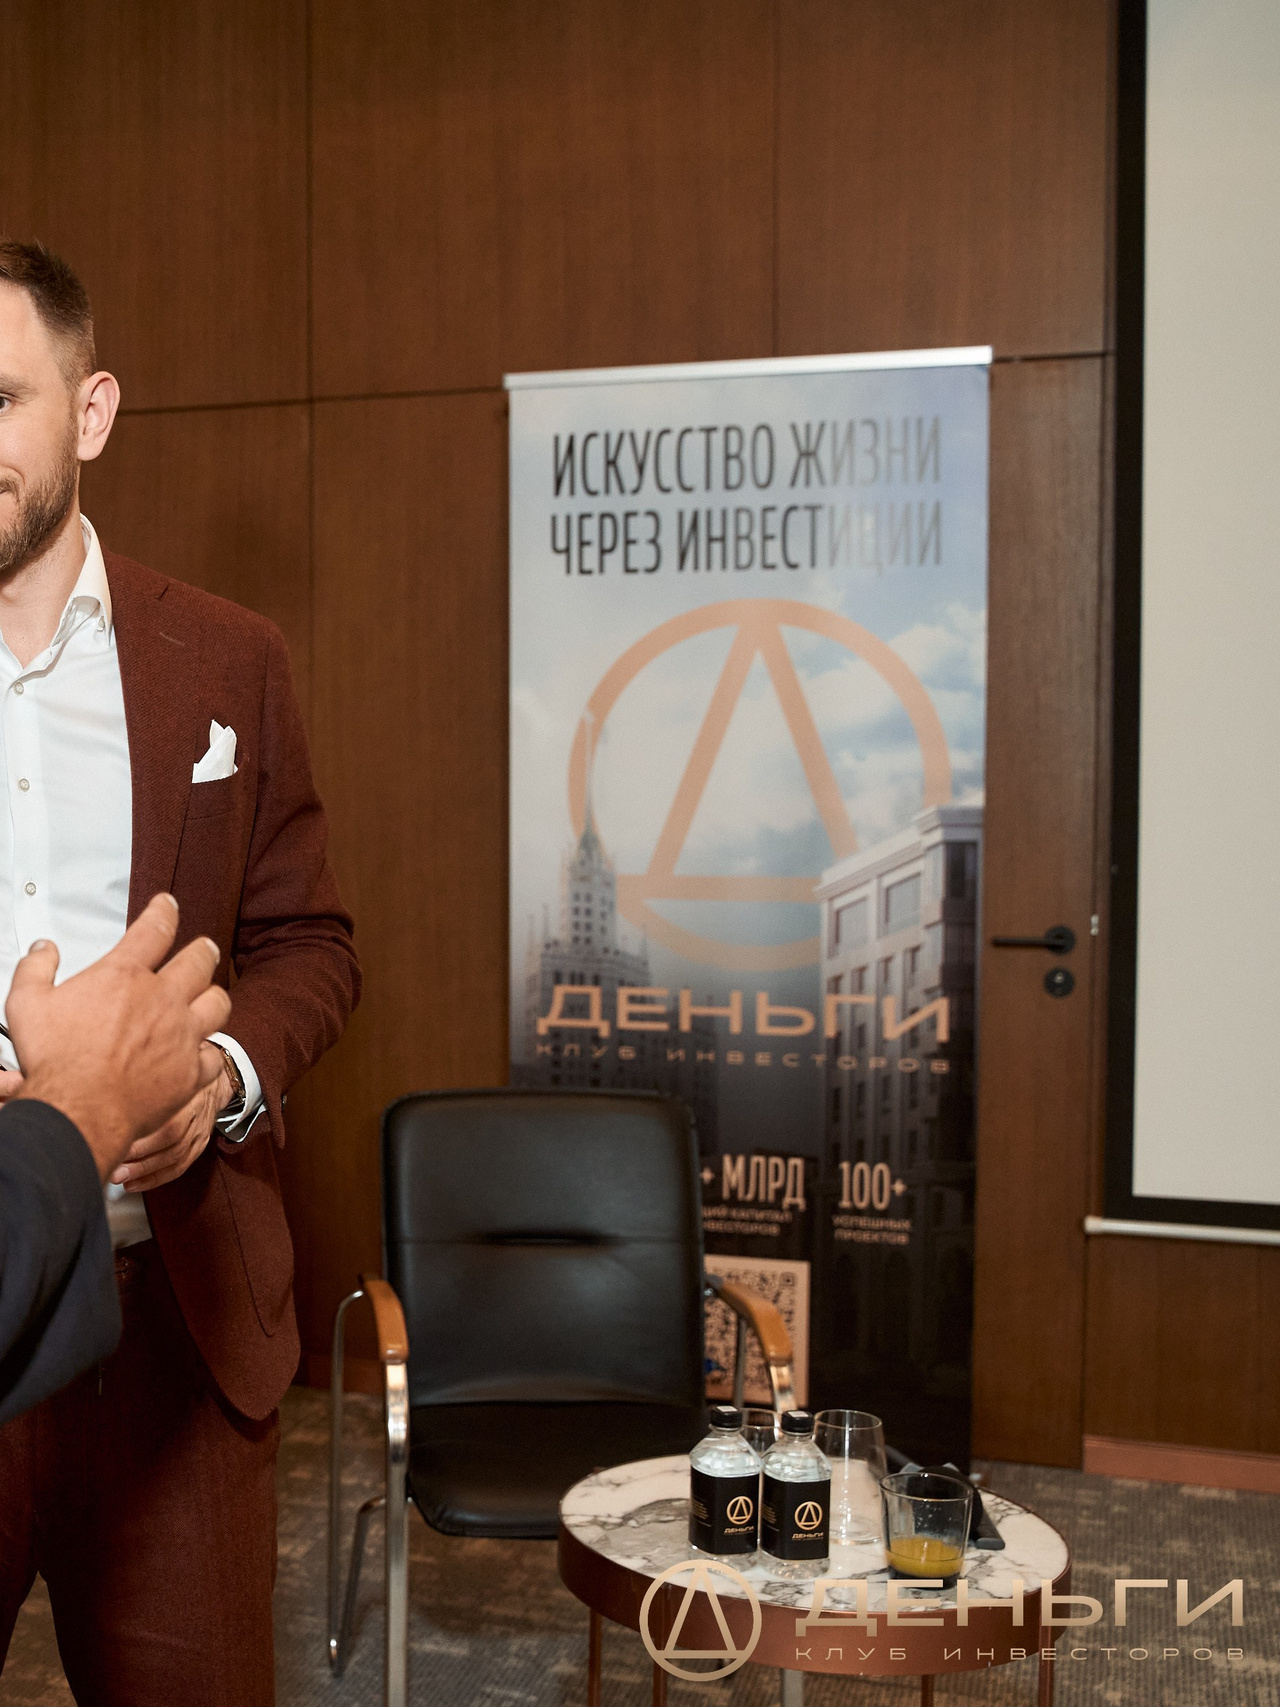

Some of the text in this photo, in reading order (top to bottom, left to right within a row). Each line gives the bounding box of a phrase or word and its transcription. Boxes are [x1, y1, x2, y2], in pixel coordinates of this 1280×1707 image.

[553, 415, 942, 498] ИСКУССТВО ЖИЗНИ
[549, 500, 942, 577] ЧЕРЕЗ ИНВЕСТИЦИИ
[535, 984, 951, 1043] ДЕНЬГИ
[535, 1042, 951, 1075] КЛУБ ИНВЕСТОРОВ
[722, 1153, 807, 1212] МЛРД
[838, 1160, 908, 1211] 100+
